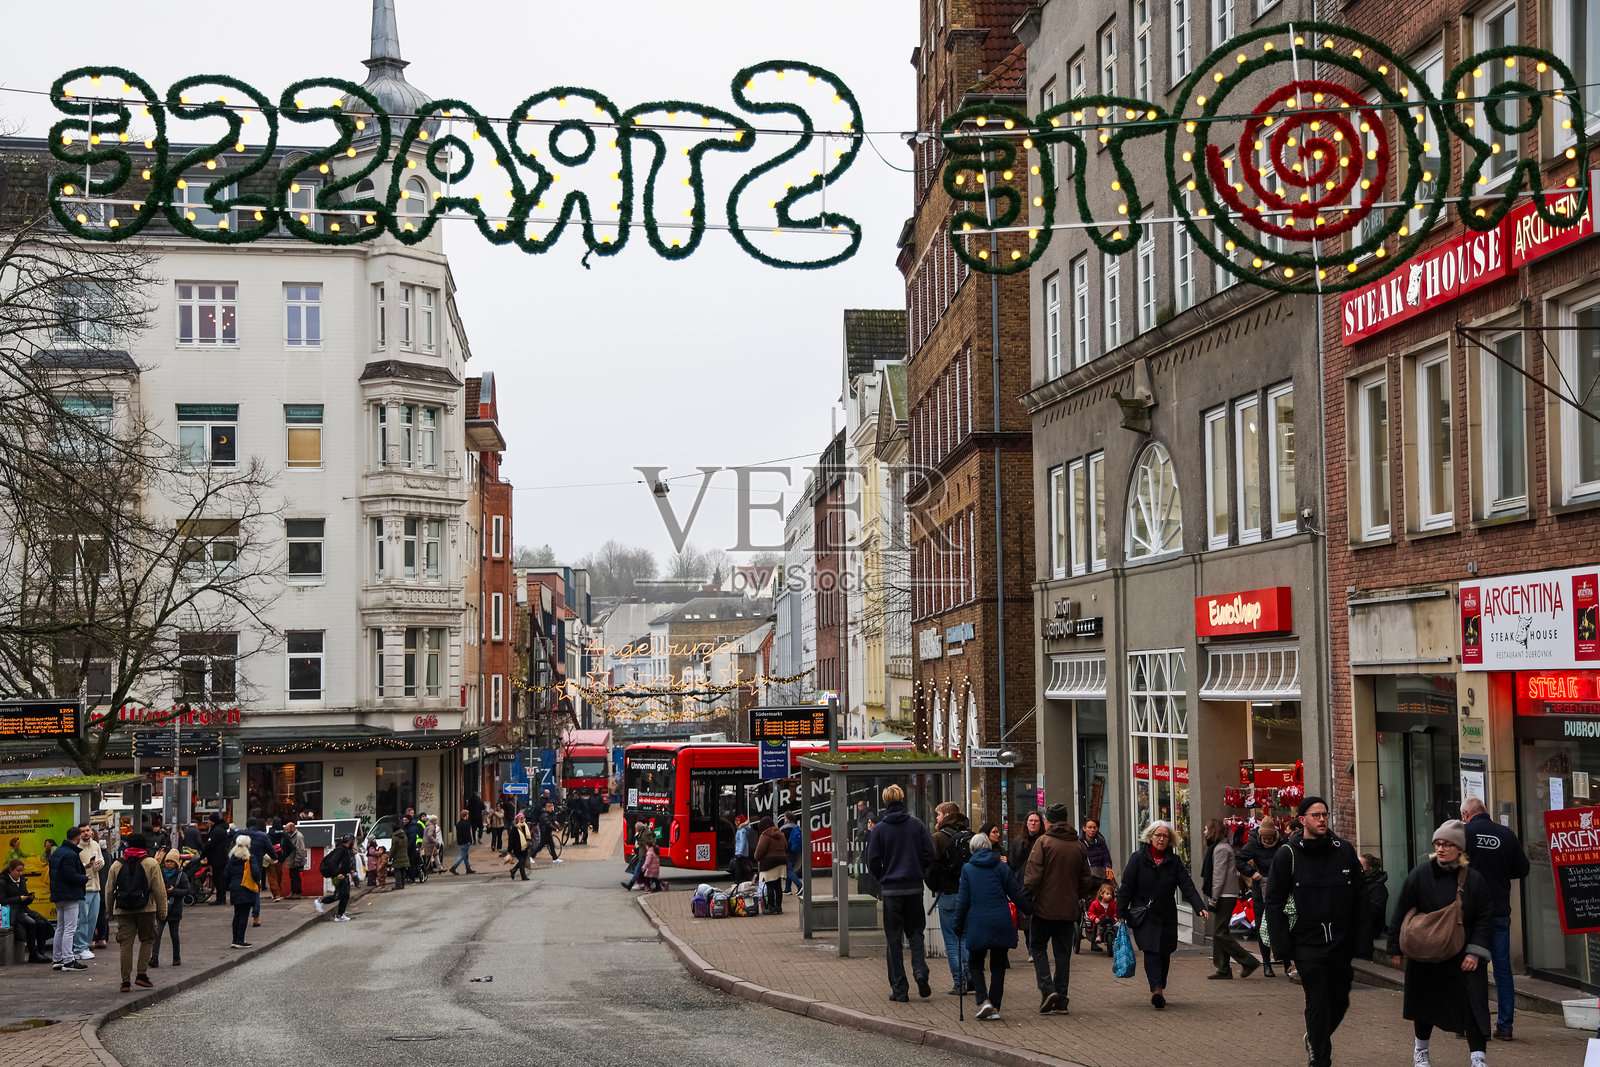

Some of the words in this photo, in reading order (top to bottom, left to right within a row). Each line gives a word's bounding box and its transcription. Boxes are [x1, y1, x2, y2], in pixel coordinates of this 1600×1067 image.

[1344, 276, 1404, 337] STEAK
[1425, 226, 1501, 300] HOUSE
[1483, 581, 1564, 624] ARGENTINA
[1208, 594, 1262, 630] EuroShop
[1490, 631, 1515, 642] STEAK
[1530, 629, 1558, 640] HOUSE
[583, 635, 745, 664] Angelburger
[1496, 651, 1524, 659] RESTAURANT
[1525, 650, 1553, 659] DUBROVNIK
[1467, 687, 1475, 706] 9
[1528, 676, 1578, 699] STEAK
[415, 713, 439, 728] Café
[1564, 720, 1600, 738] DUBROV
[630, 761, 657, 770] Unnormal
[656, 763, 669, 771] gut.
[755, 789, 791, 812] WR
[1549, 820, 1580, 830] STEAK
[1476, 836, 1497, 846] ZVO
[1555, 852, 1600, 863] SÜDERM
